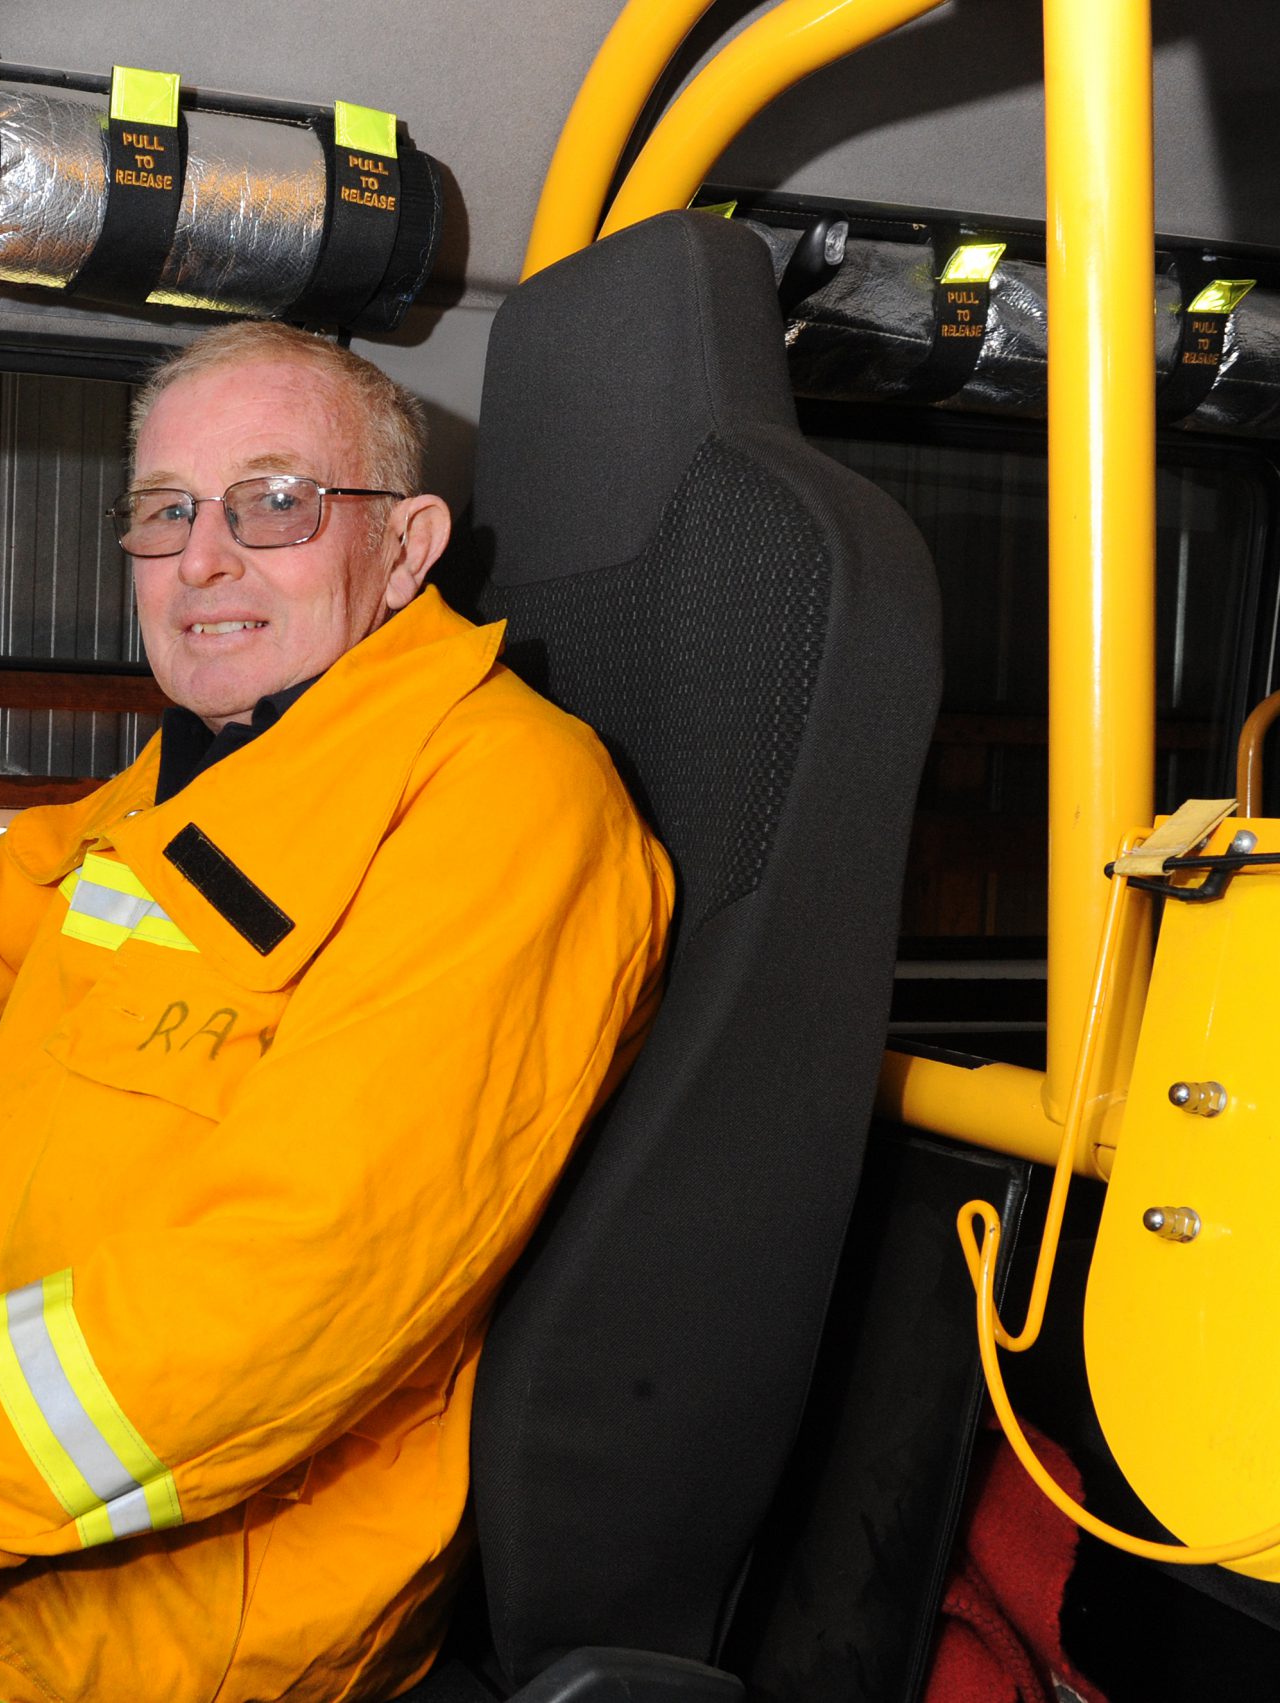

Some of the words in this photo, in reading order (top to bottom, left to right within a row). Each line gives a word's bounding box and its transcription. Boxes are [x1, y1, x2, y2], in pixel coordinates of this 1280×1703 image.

[123, 132, 164, 151] PULL
[135, 155, 154, 169] TO
[349, 155, 388, 176] PULL
[116, 169, 173, 190] RELEASE
[360, 176, 379, 190] TO
[341, 186, 395, 211] RELEASE
[947, 291, 979, 304] PULL
[956, 309, 970, 321] TO
[941, 324, 983, 337] RELEASE
[136, 1000, 238, 1061] RA
